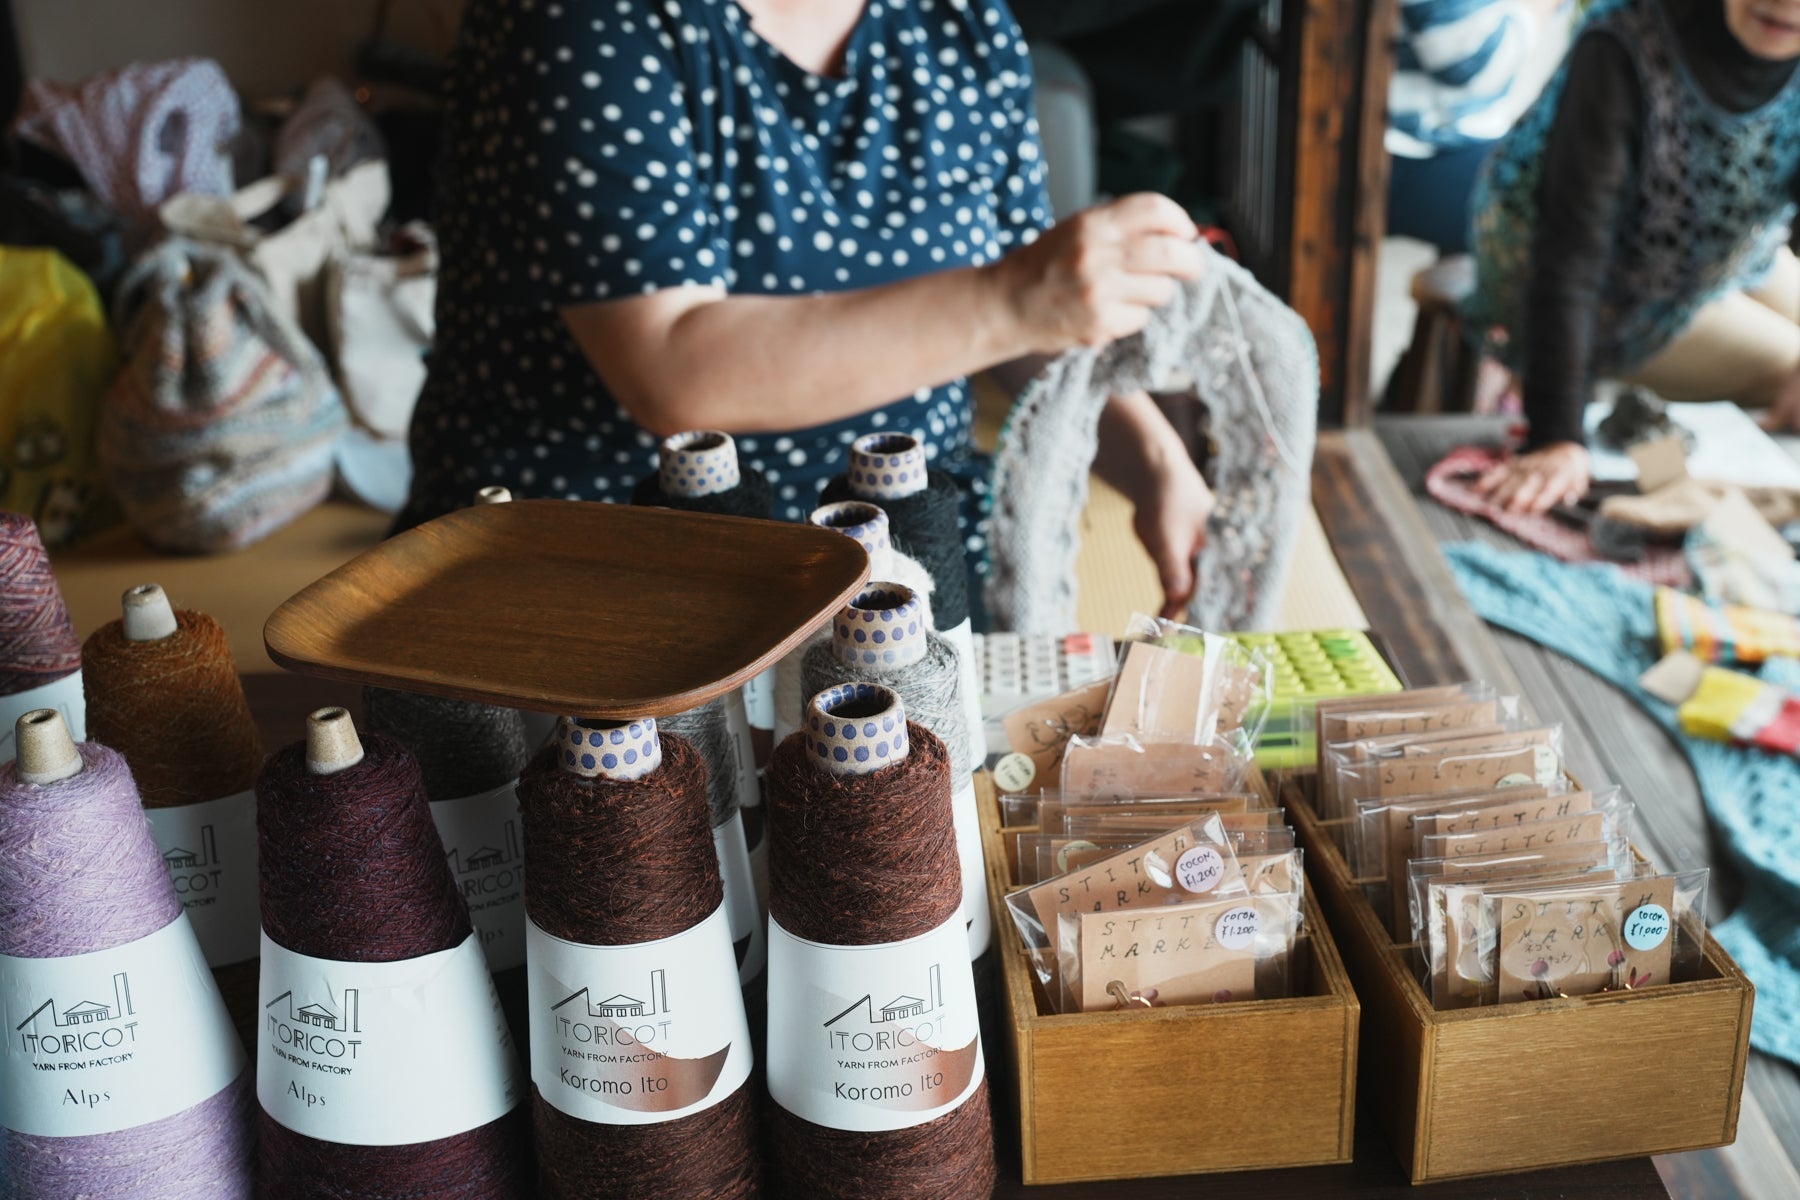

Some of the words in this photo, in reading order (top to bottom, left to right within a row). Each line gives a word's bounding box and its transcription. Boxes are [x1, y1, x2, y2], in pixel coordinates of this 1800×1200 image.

[22, 1022, 138, 1054] ITORICOT
[267, 1012, 362, 1059] ITORICOT
[555, 1015, 671, 1045] ITORICOT
[829, 1015, 945, 1051] ITORICOT
[33, 1062, 56, 1071] YARN
[59, 1062, 86, 1071] FROM
[90, 1052, 133, 1067] FACTORY
[272, 1043, 286, 1059] YARN
[288, 1053, 309, 1068] FROM
[312, 1062, 352, 1075] FACTORY
[562, 1046, 585, 1059] YARN
[587, 1053, 616, 1063] FROM
[620, 1051, 669, 1063] FACTORY
[837, 1060, 865, 1069] YARN
[868, 1059, 899, 1069] FROM
[287, 1080, 326, 1107] Alps
[560, 1067, 632, 1094] Koromo
[641, 1076, 668, 1093] Ito
[835, 1081, 913, 1100] Koromo
[921, 1072, 943, 1091] Ito
[62, 1089, 111, 1108] Alps
